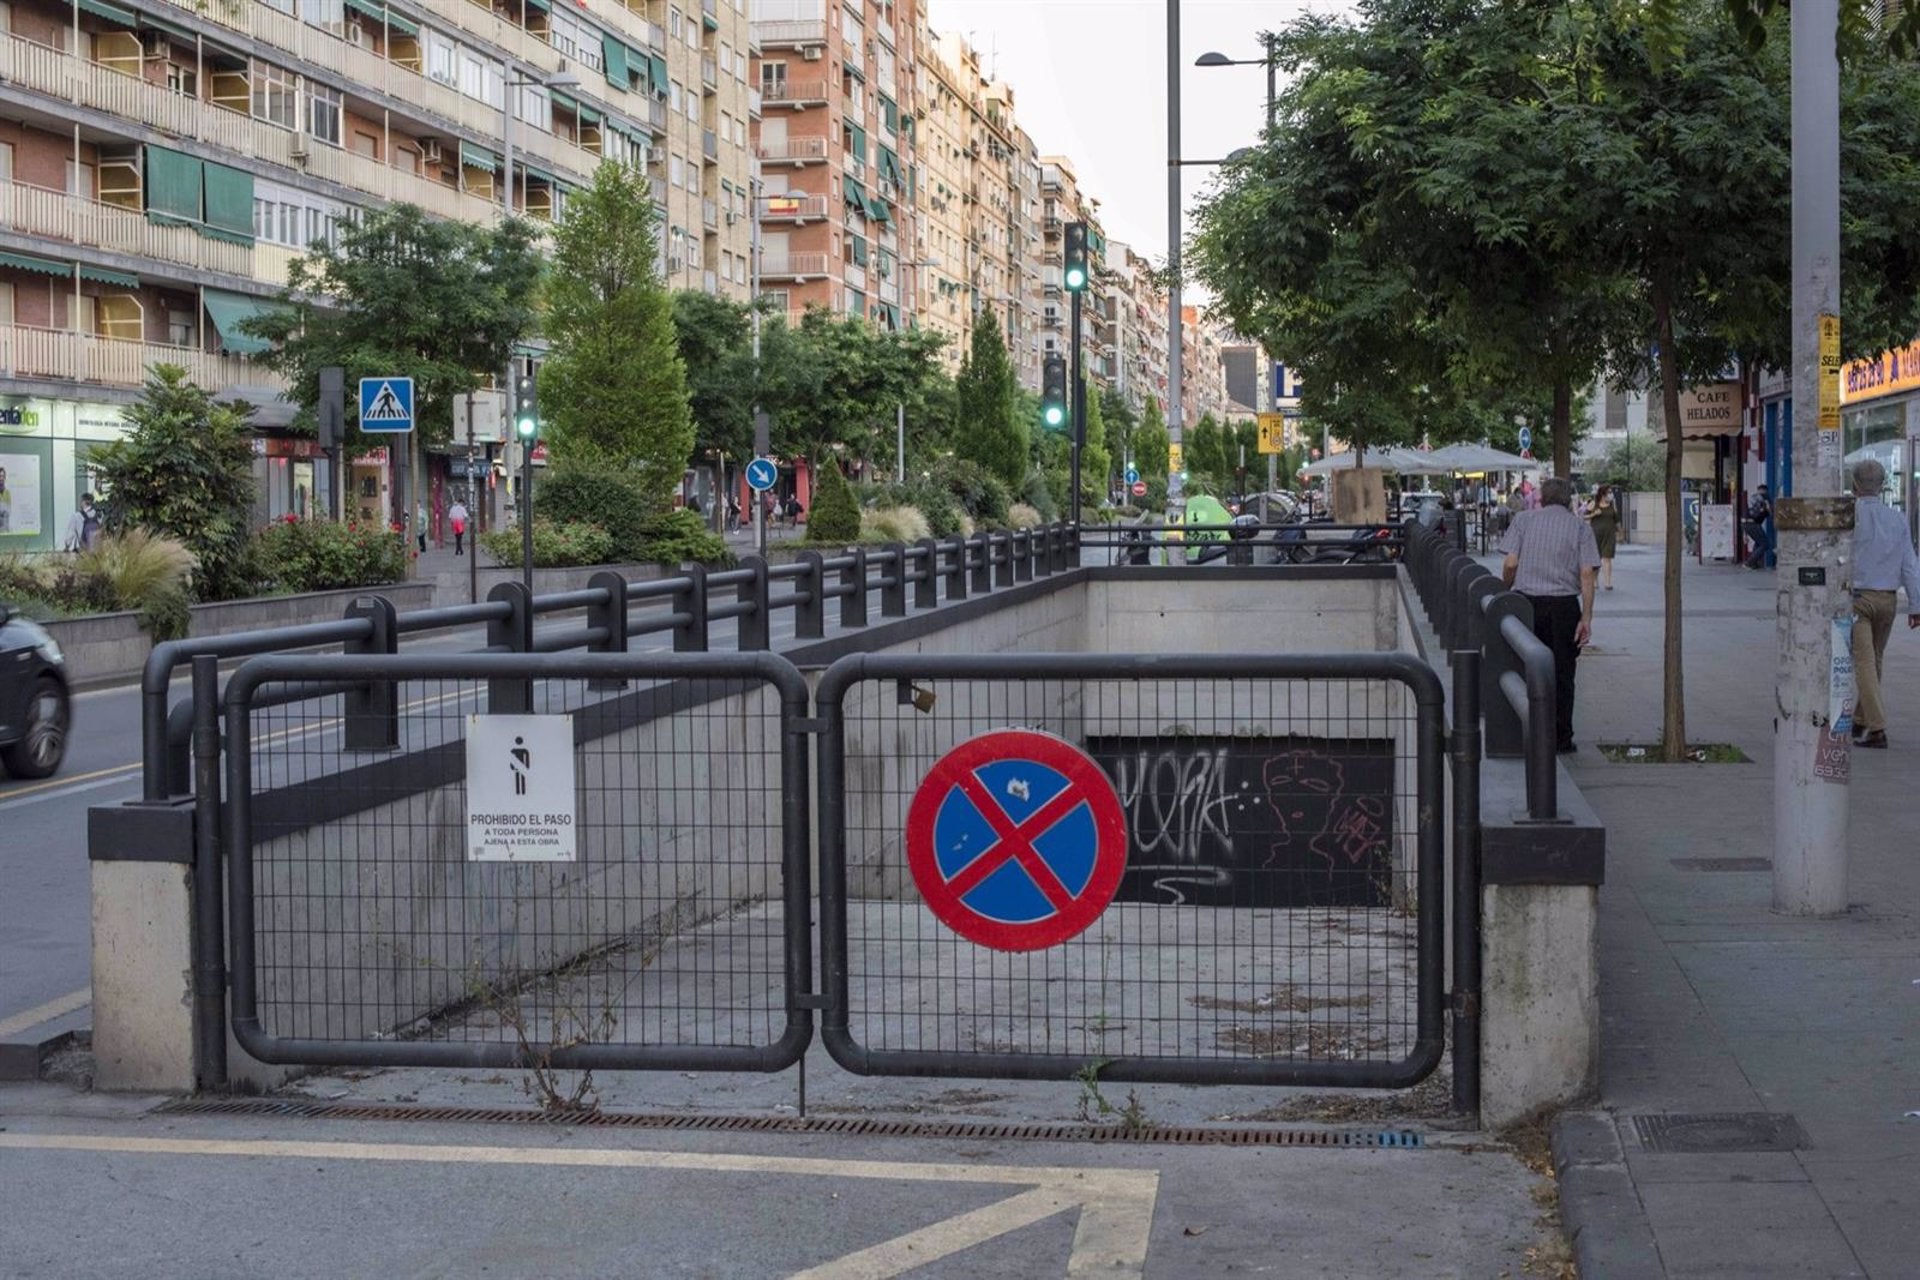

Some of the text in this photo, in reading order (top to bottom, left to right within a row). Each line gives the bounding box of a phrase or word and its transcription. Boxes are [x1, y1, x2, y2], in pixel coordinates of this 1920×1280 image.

[1687, 407, 1730, 420] HELADOS
[471, 814, 572, 826] PROHIBIDO EL PASO
[484, 828, 559, 836] A TODA PERSONA
[484, 838, 559, 846] AJENA A ESTA OBRA
